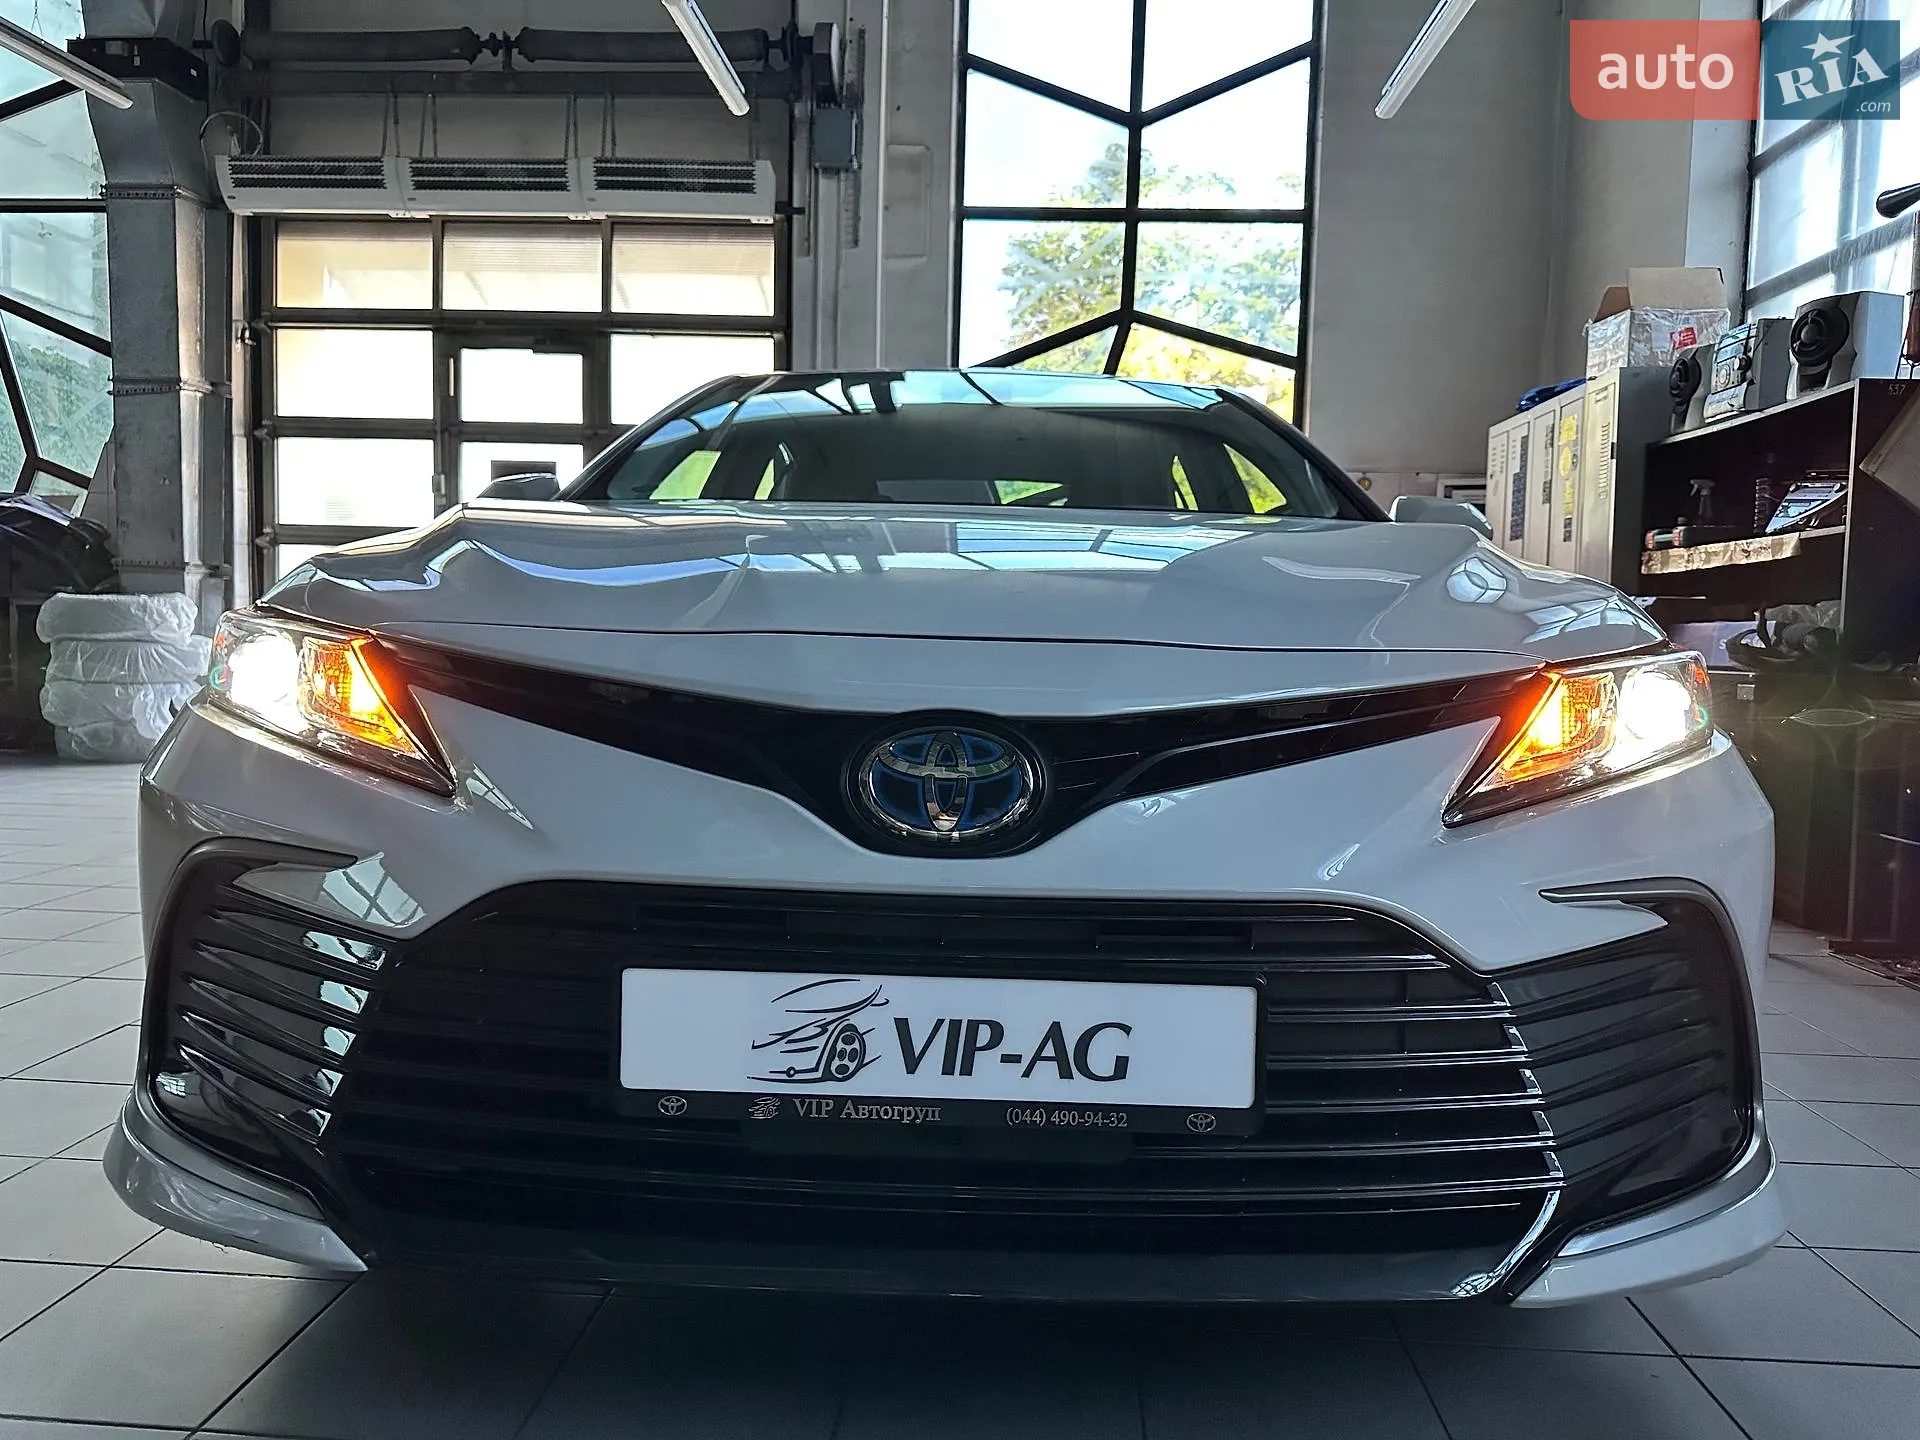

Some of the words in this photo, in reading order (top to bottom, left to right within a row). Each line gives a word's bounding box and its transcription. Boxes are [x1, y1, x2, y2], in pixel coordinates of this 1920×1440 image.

[893, 1017, 1133, 1082] VIP-AG
[793, 1098, 834, 1118] VIP
[840, 1099, 942, 1124] Автогруп
[1006, 1107, 1047, 1127] (044)
[1050, 1110, 1128, 1127] 490-94-32
